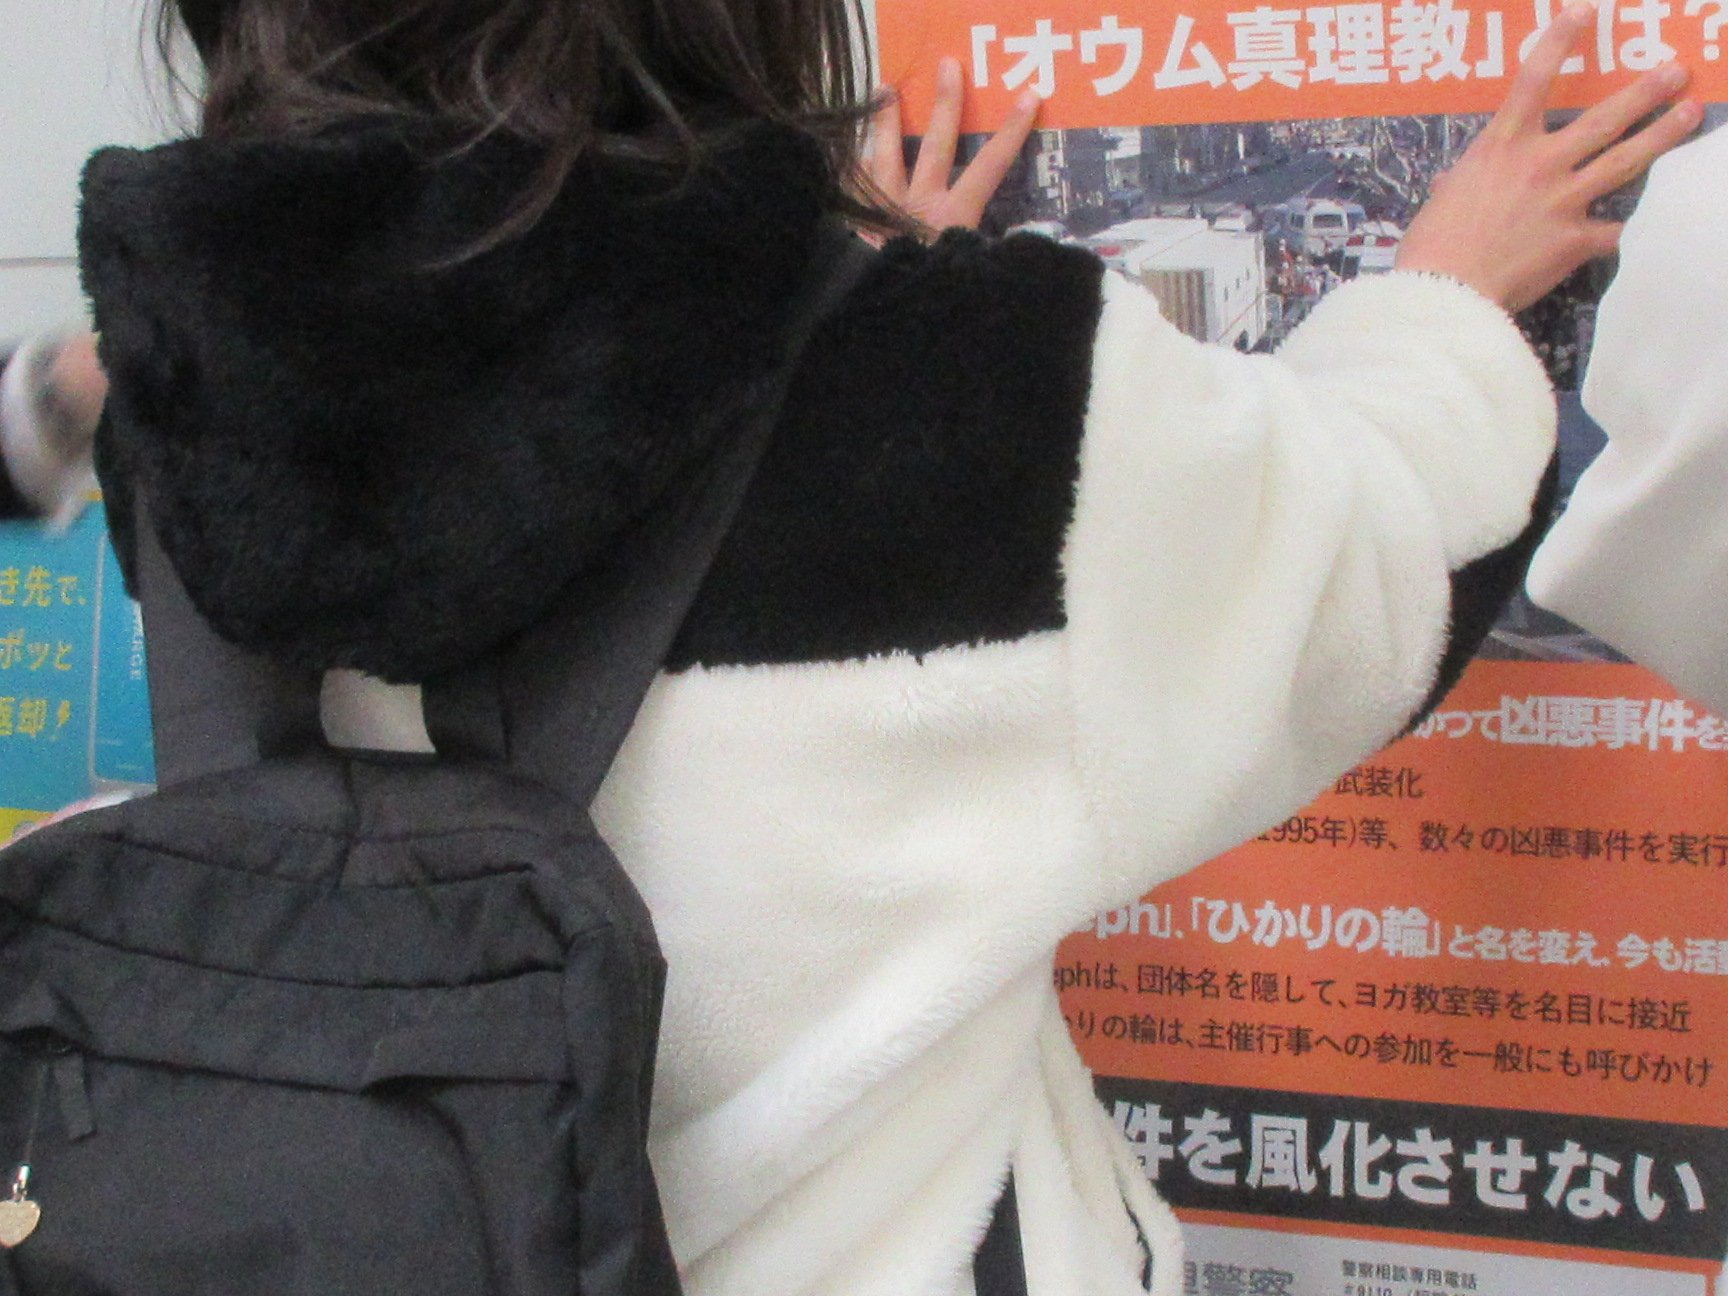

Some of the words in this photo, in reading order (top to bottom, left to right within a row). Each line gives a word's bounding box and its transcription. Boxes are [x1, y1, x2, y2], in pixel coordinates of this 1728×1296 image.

[1063, 1010, 1714, 1088] りの輪は、主催行事への参加を一般にも呼びかけ
